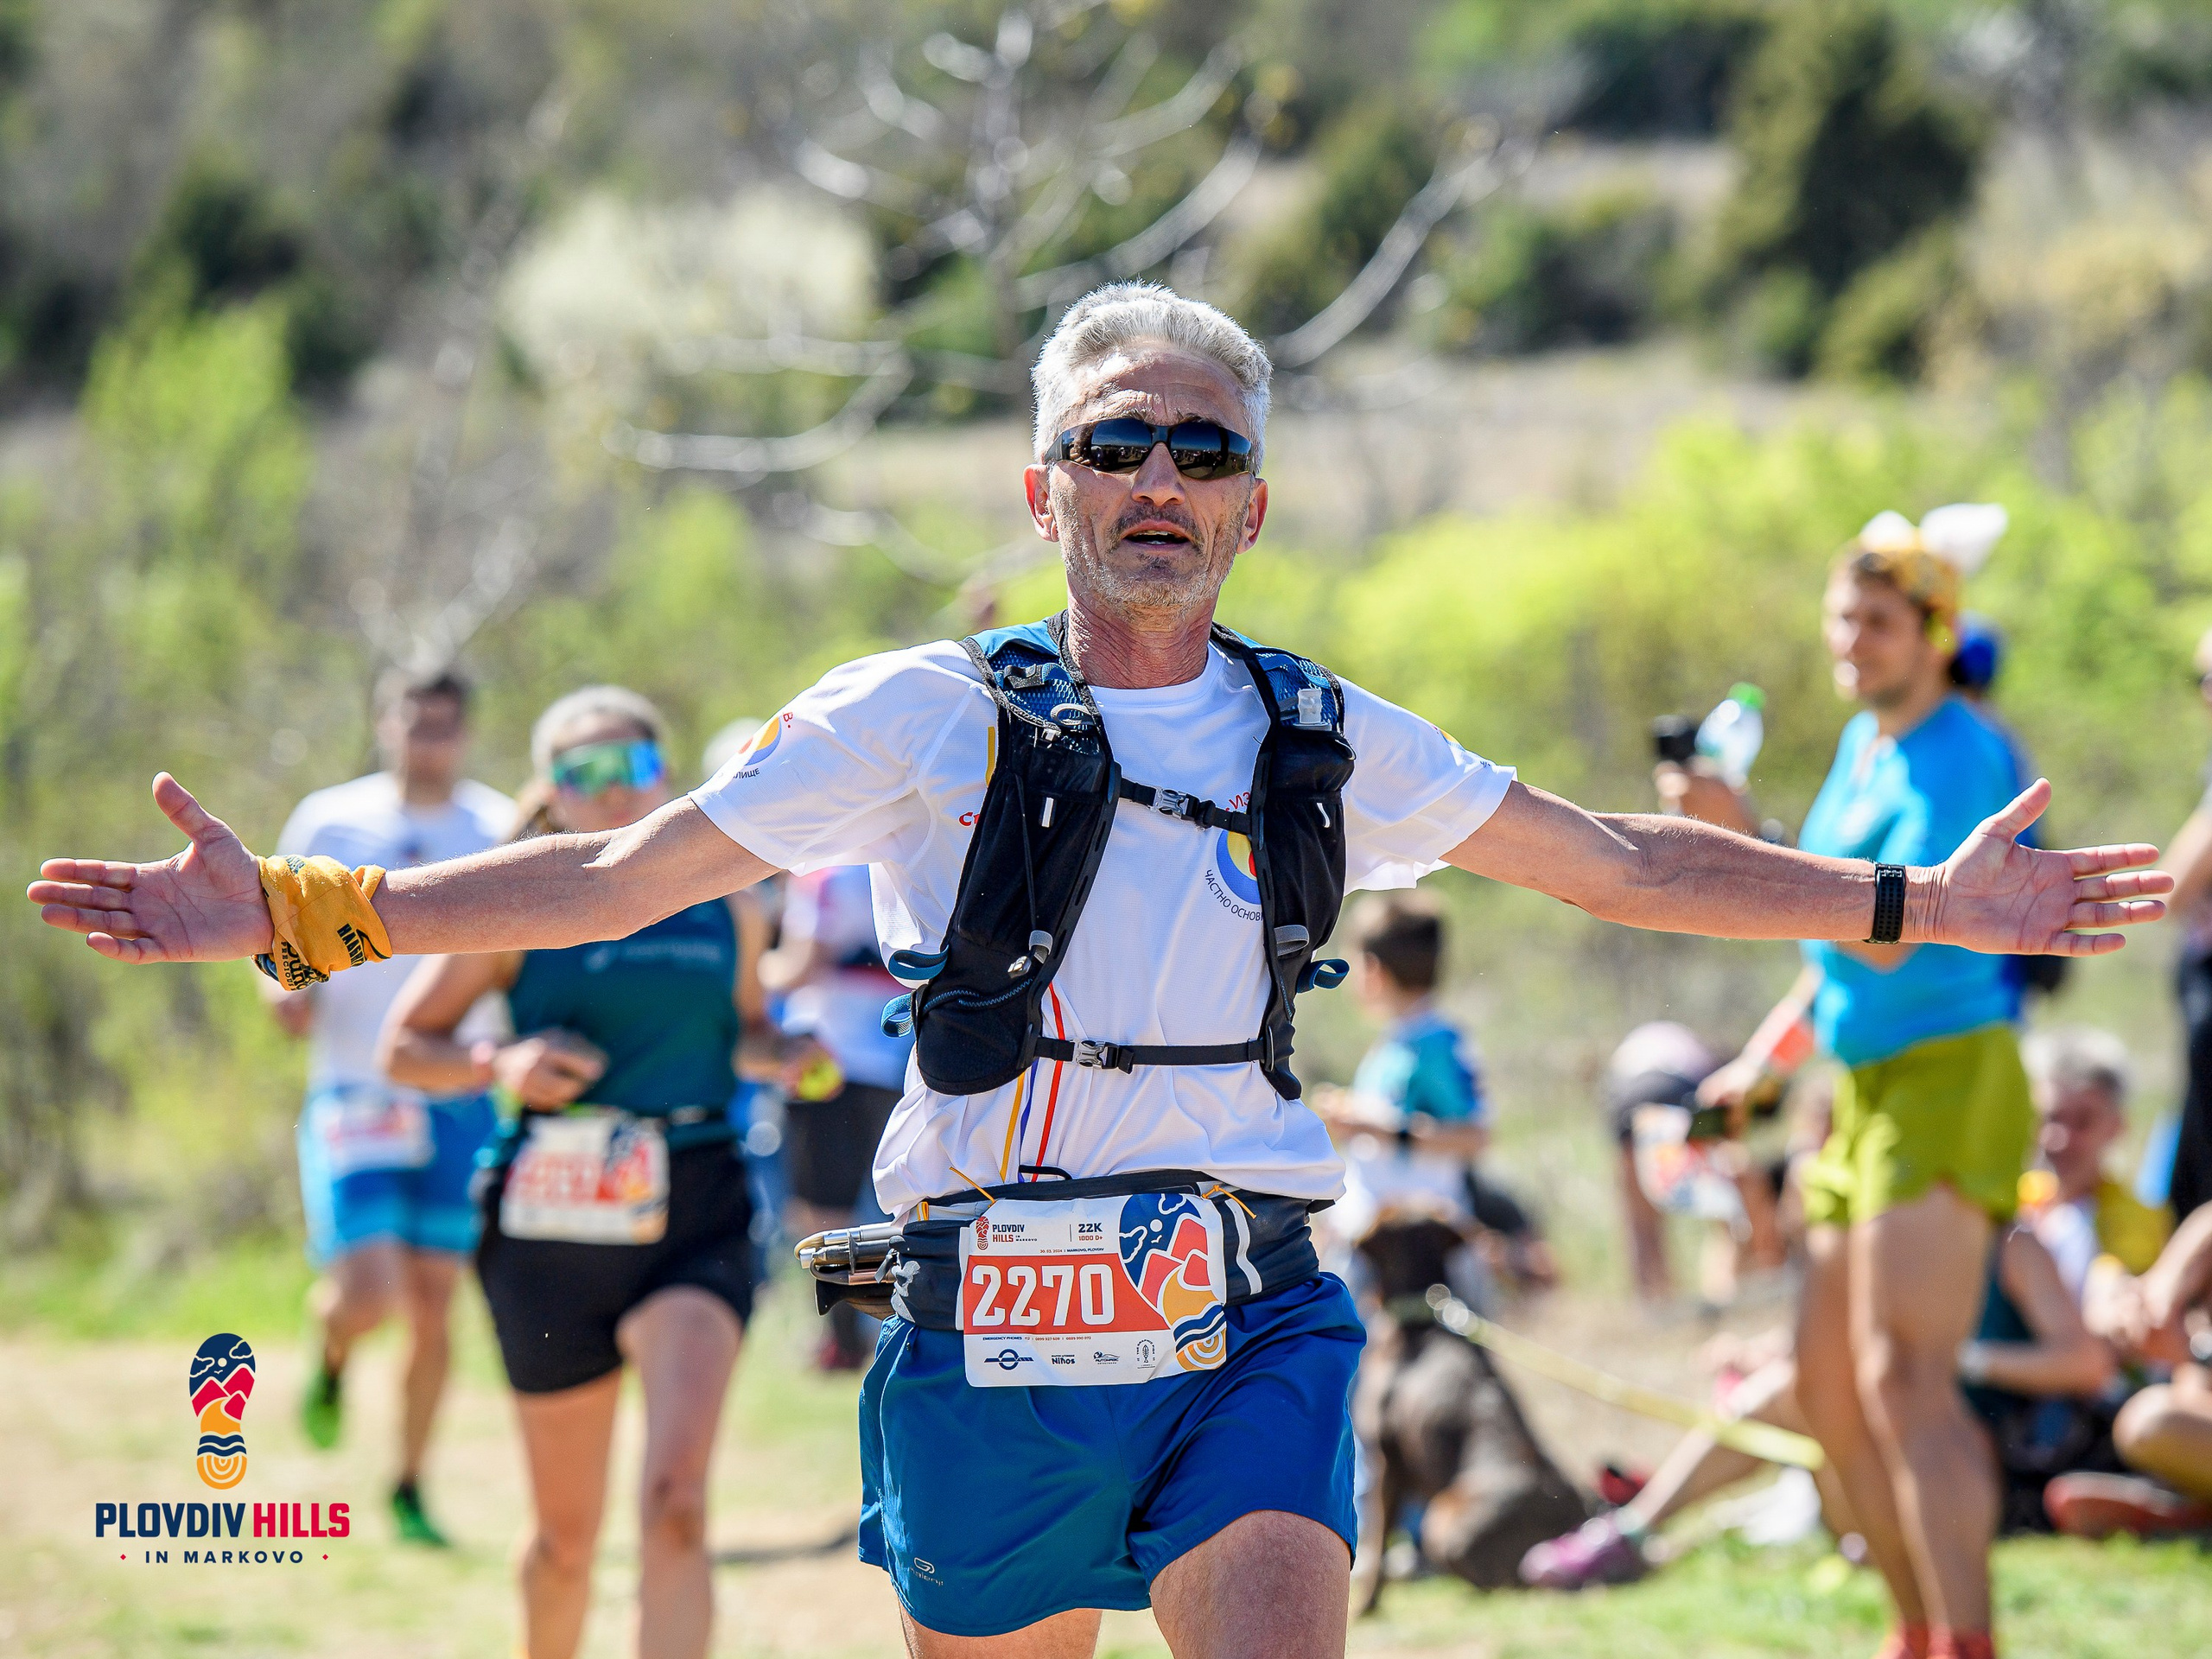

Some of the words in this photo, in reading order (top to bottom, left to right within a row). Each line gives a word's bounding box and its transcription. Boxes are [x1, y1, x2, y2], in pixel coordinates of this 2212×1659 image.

[1205, 869, 1231, 908] ЧАСТНО
[992, 1224, 1025, 1233] PLOVDIV
[1077, 1223, 1103, 1233] 22K
[992, 1234, 1014, 1243] HILLS
[971, 1263, 1116, 1327] 2270
